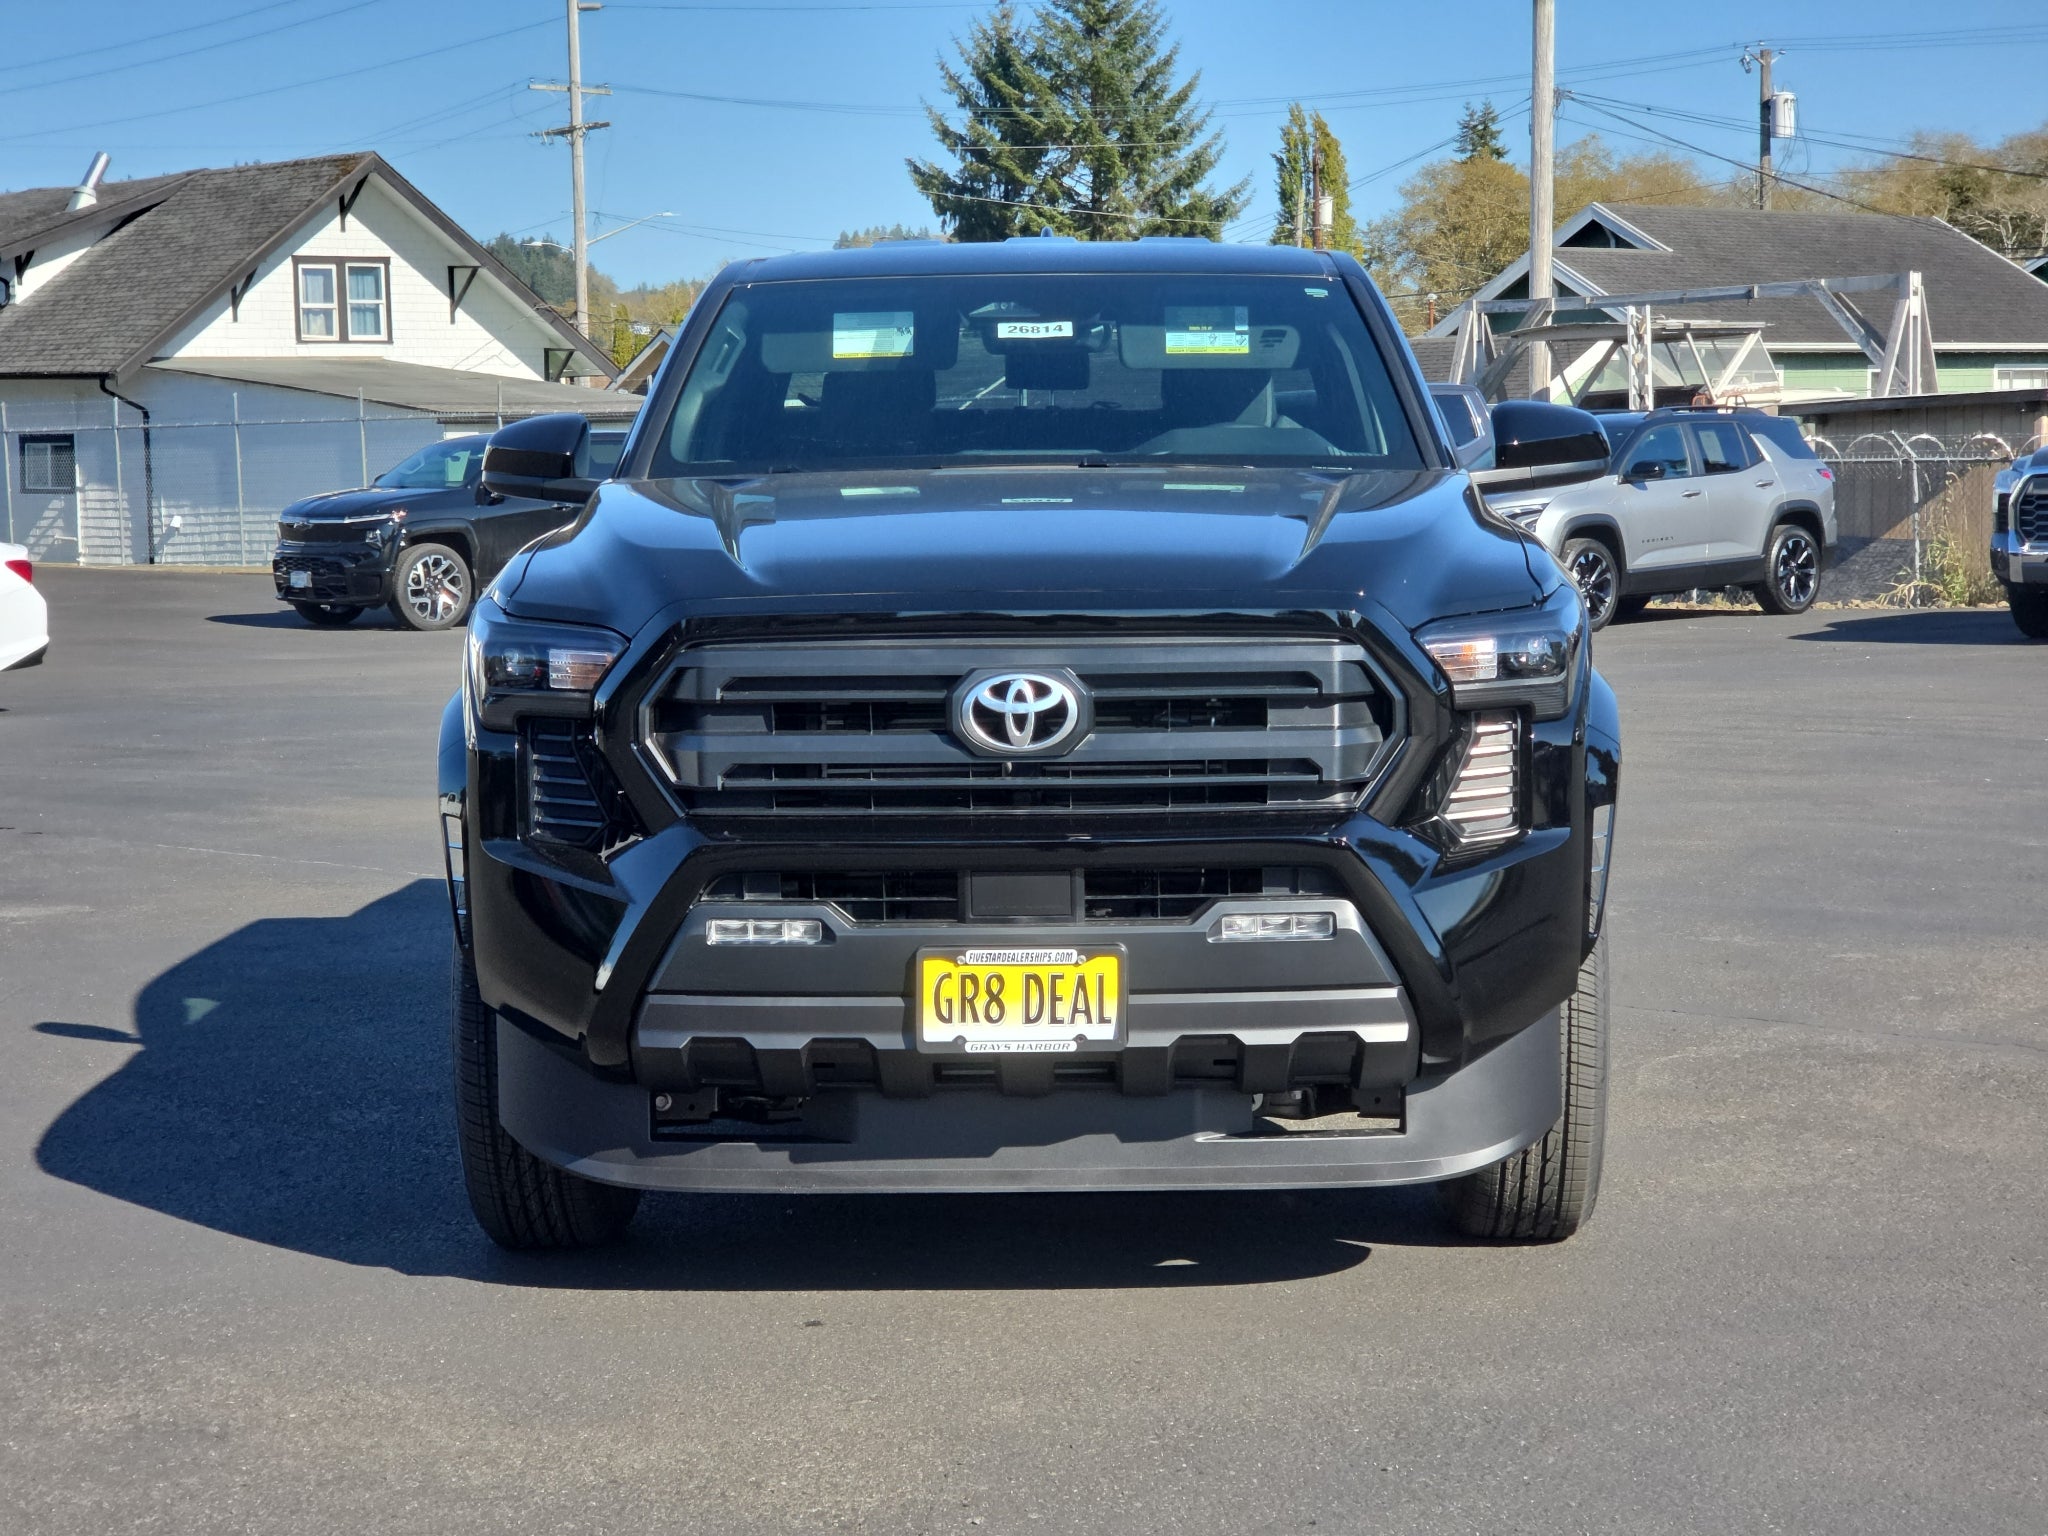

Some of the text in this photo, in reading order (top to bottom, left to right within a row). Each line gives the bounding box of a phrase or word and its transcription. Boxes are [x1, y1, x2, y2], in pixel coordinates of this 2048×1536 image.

[1007, 325, 1064, 334] 26814
[968, 951, 1074, 964] FIVESTARDEALERSHIPS.COM
[933, 972, 1113, 1026] GR8 DEAL
[970, 1042, 1071, 1052] GRAYS HARBOR
